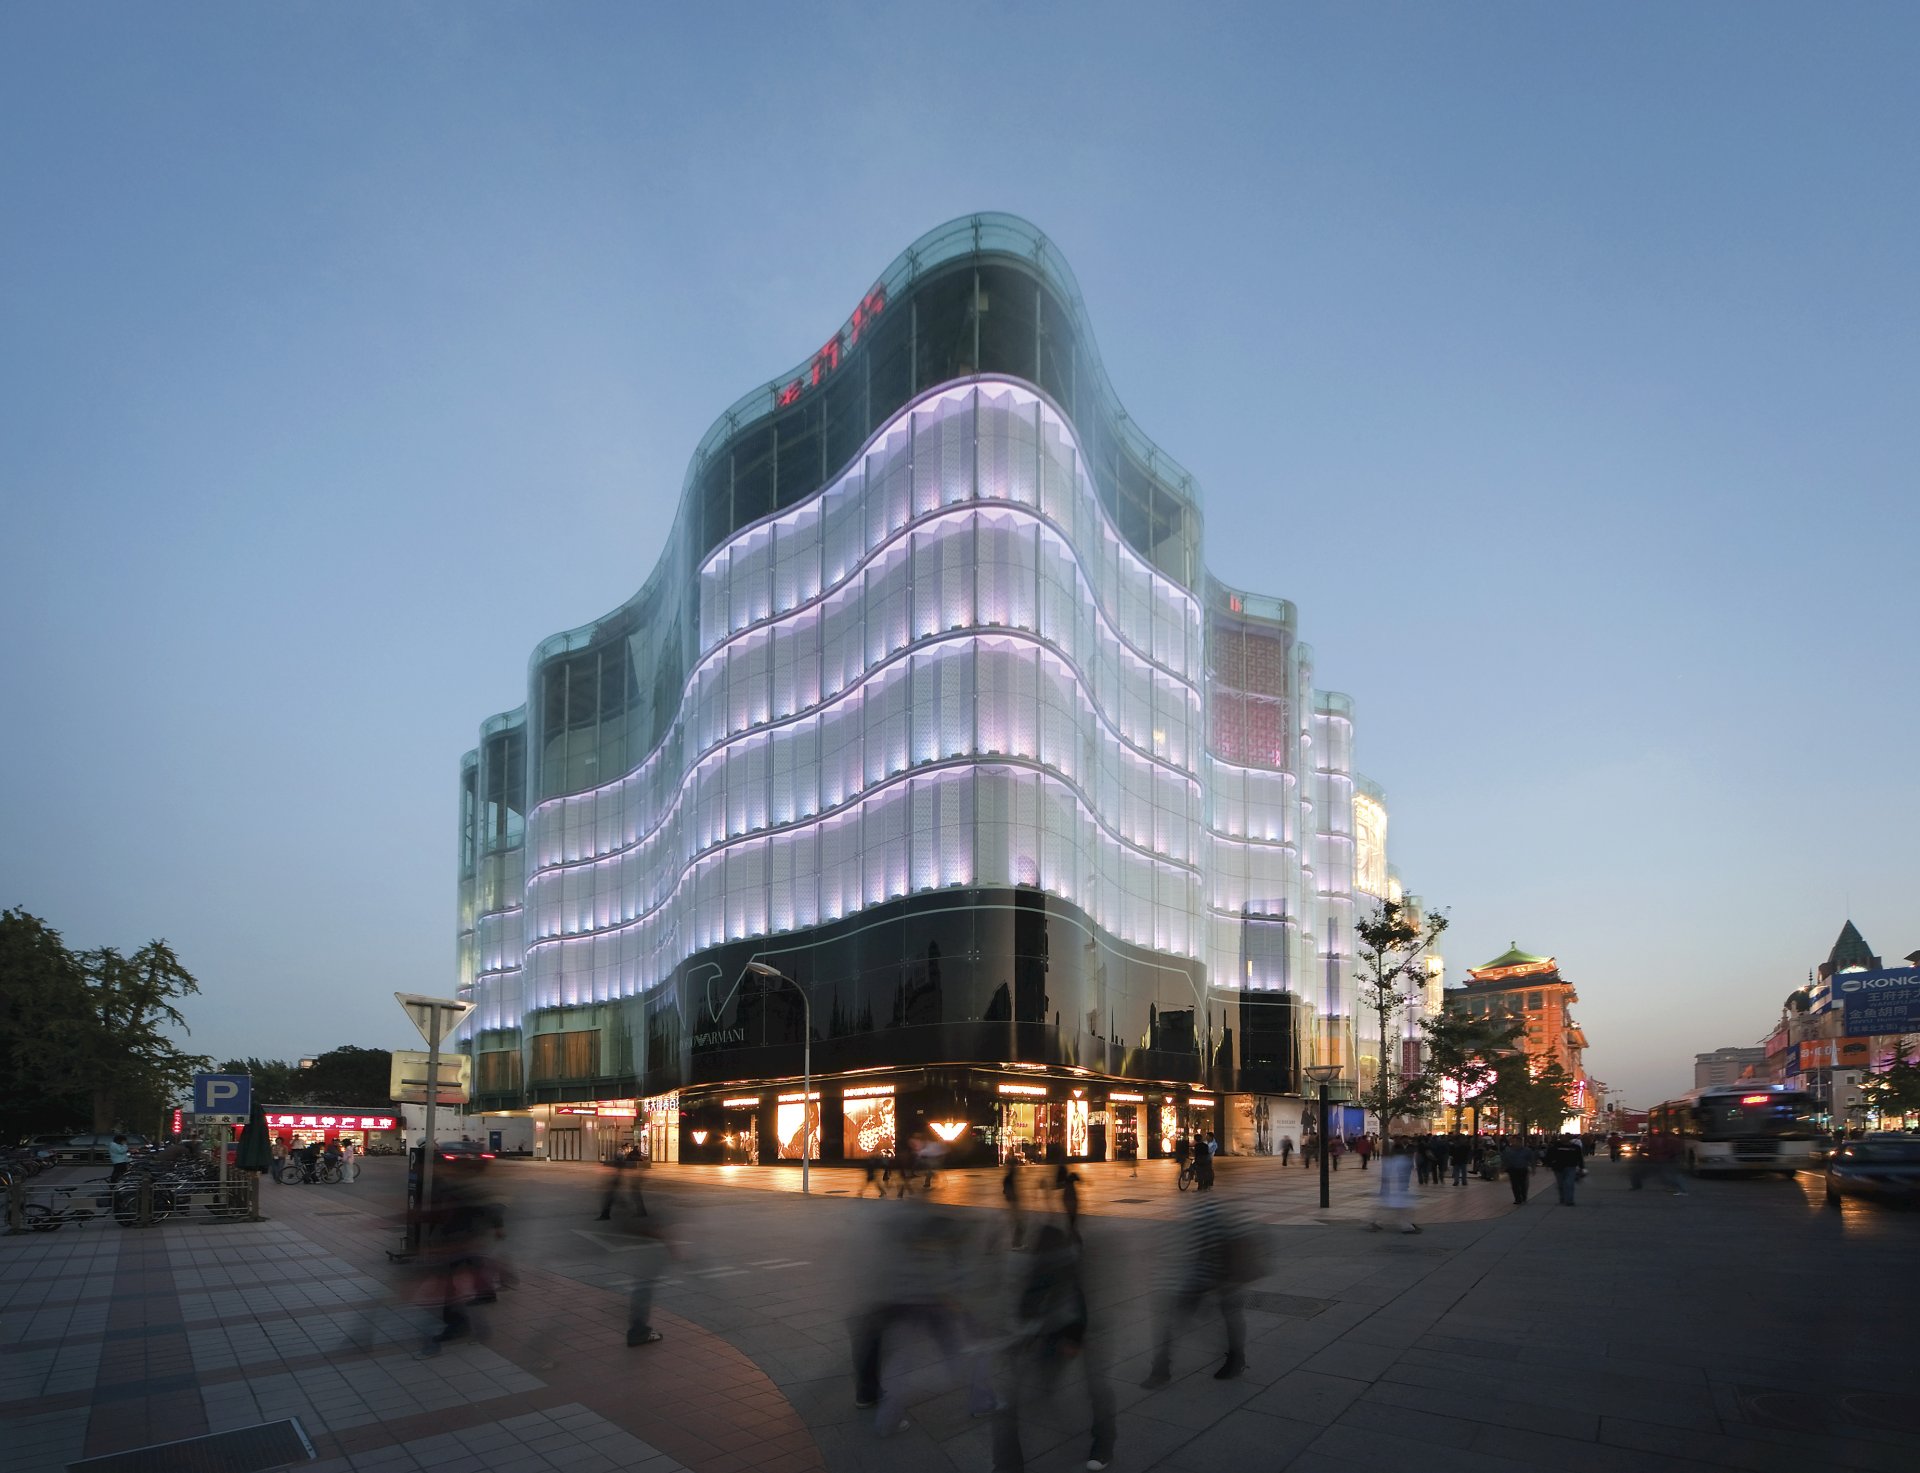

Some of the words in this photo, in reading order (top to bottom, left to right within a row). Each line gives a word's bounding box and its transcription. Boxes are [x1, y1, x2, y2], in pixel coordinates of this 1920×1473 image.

[1863, 975, 1920, 989] KONIC
[1850, 1006, 1908, 1019] 金鱼胡同
[706, 1028, 744, 1045] ARMANI
[206, 1080, 239, 1108] P
